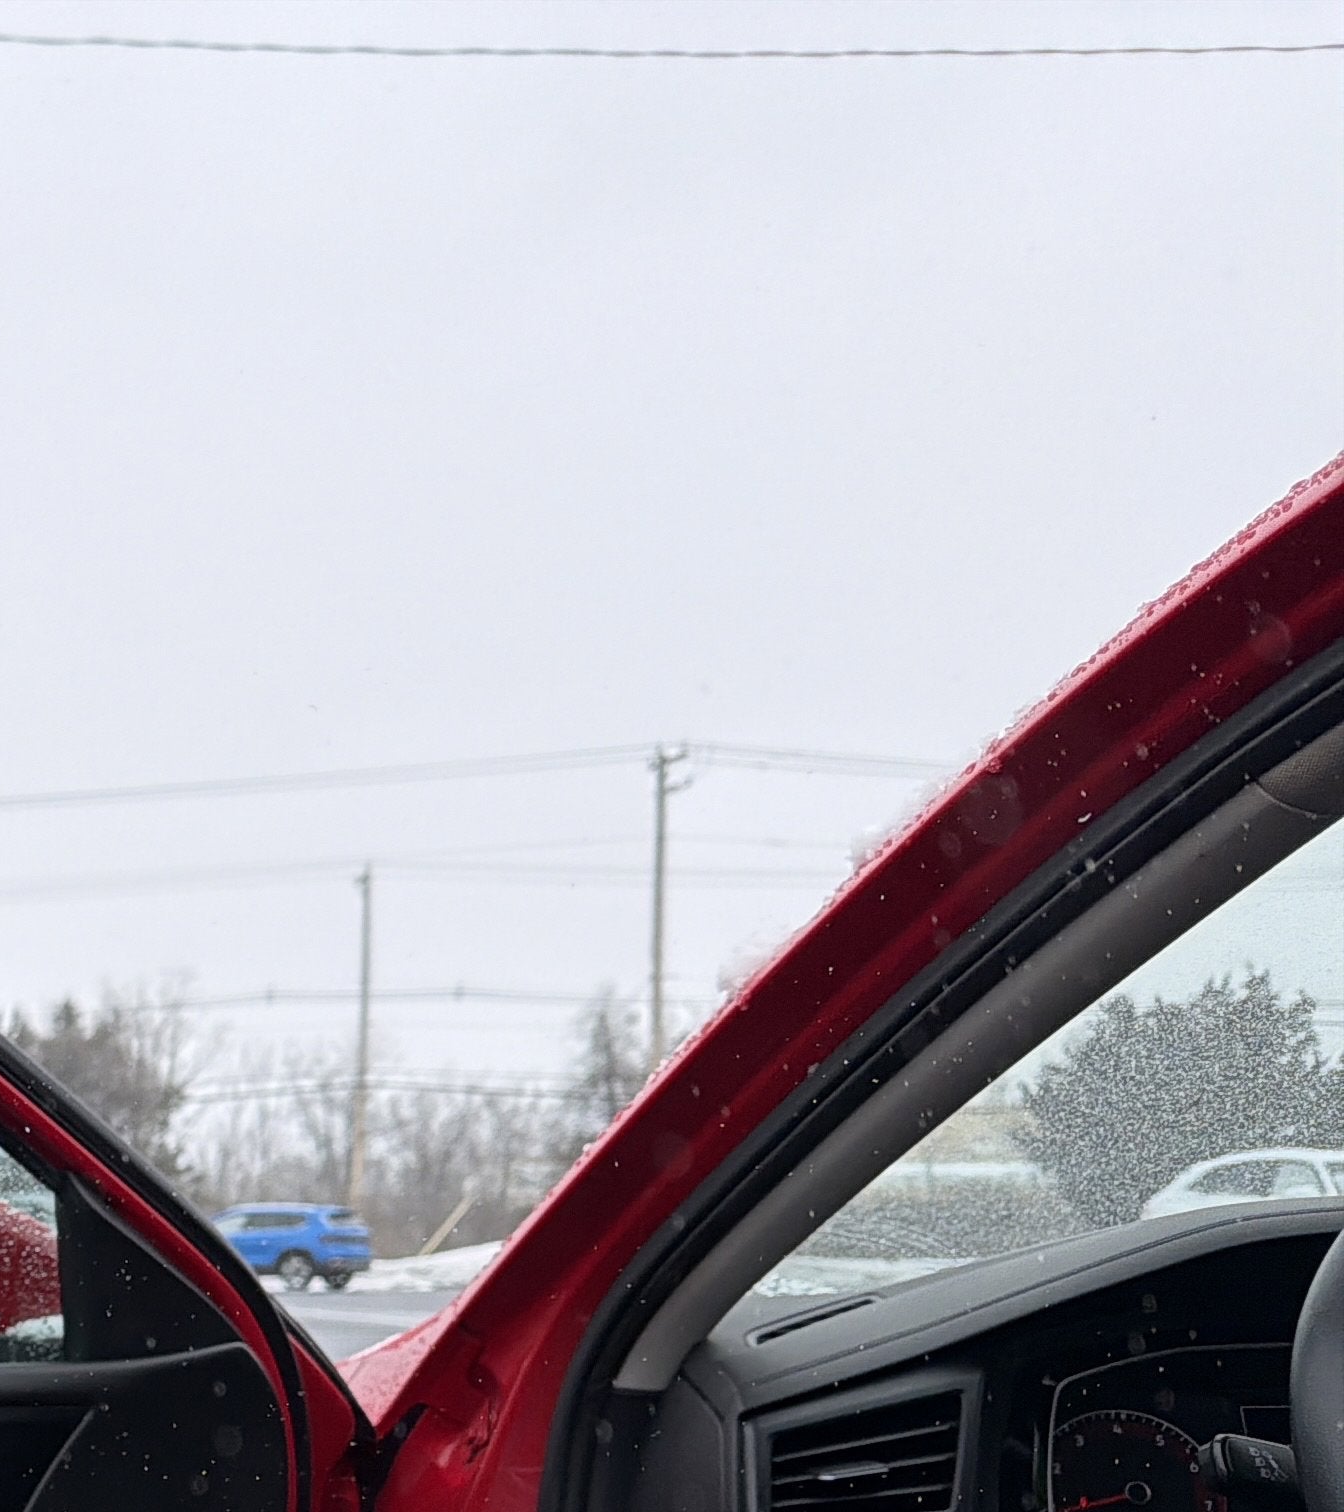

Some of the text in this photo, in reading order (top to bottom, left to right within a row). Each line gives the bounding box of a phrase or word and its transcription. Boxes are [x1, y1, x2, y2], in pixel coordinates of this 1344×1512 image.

[1112, 1424, 1122, 1434] 4
[1074, 1434, 1085, 1448] 3
[1156, 1434, 1165, 1447] 5
[1189, 1461, 1199, 1473] 6
[1204, 1500, 1213, 1512] 7
